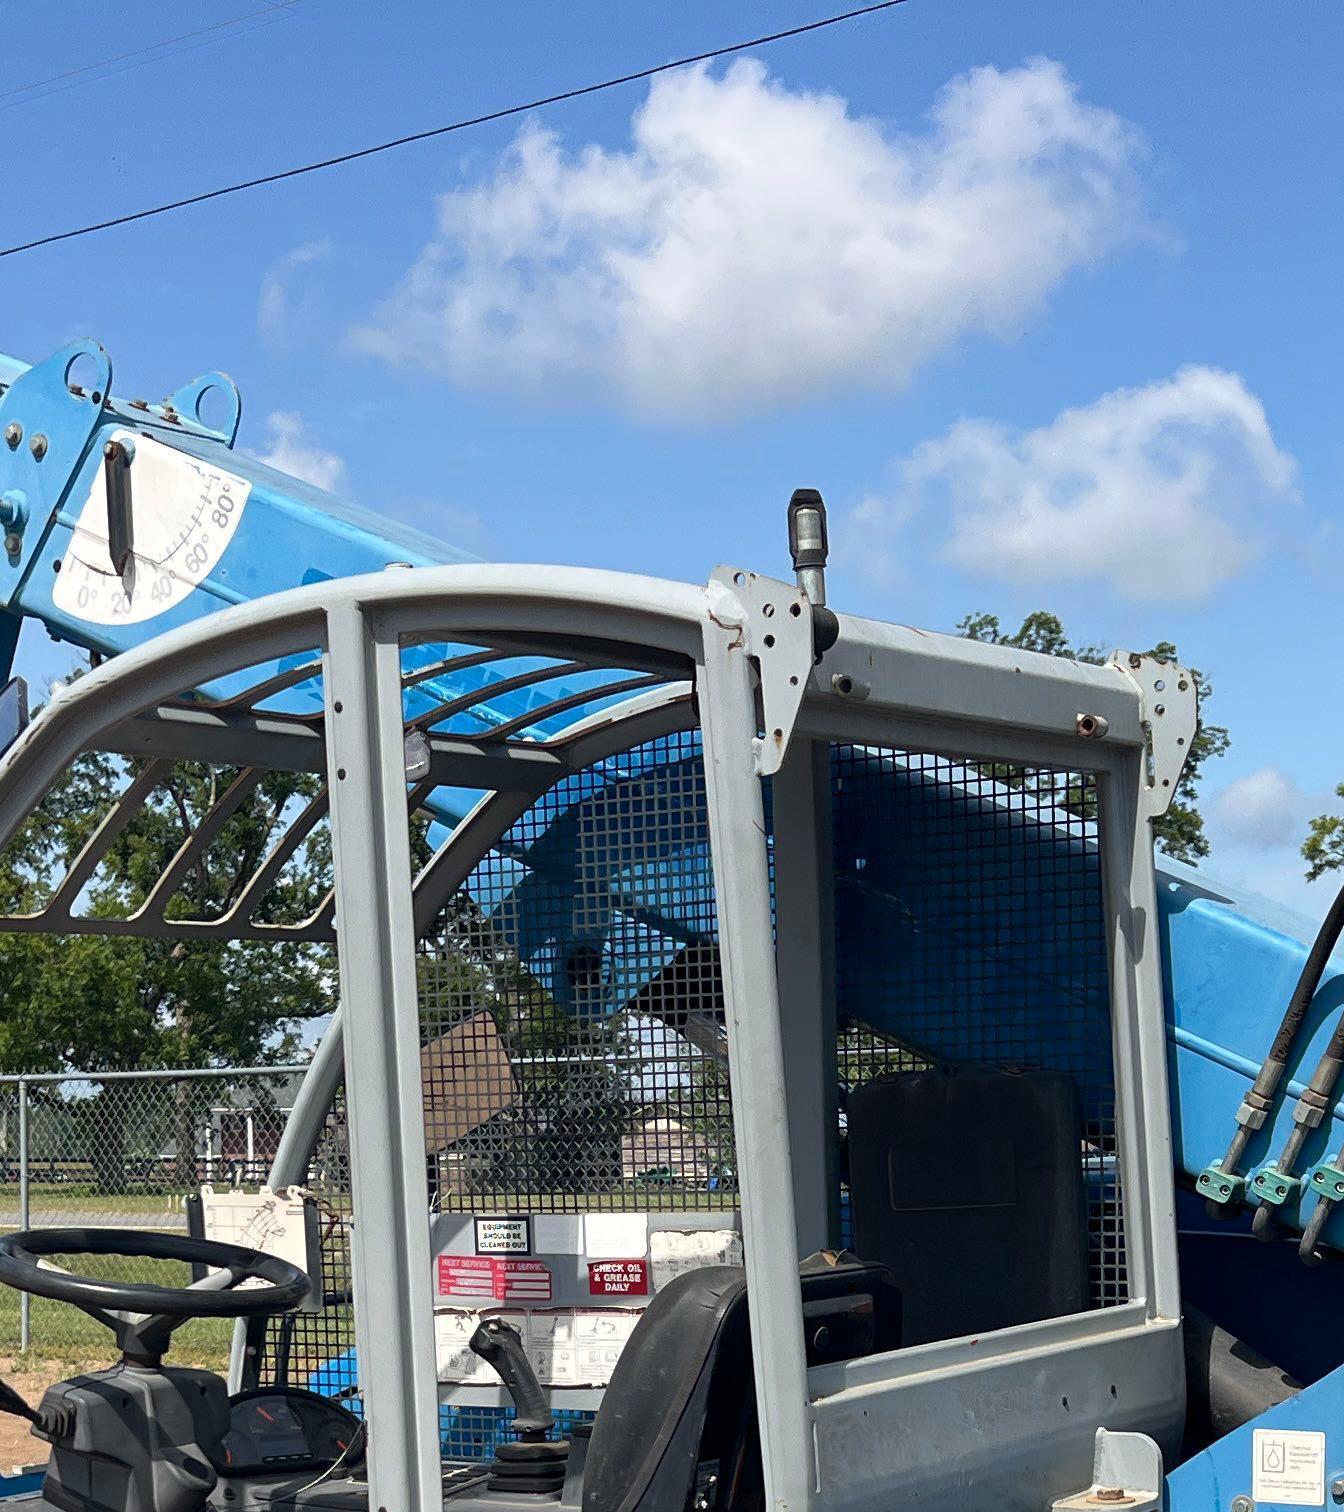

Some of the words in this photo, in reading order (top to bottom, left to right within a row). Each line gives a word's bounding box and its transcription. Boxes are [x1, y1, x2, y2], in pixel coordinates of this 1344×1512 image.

[482, 1223, 522, 1231] EQUIPMENT
[483, 1232, 512, 1240] SHOULD
[512, 1232, 522, 1240] BE
[511, 1241, 527, 1249] OUT
[592, 1263, 625, 1273] CHECK
[627, 1263, 643, 1273] OIL
[593, 1273, 601, 1282] &
[603, 1273, 642, 1283] GREASE
[604, 1282, 631, 1292] DAILY
